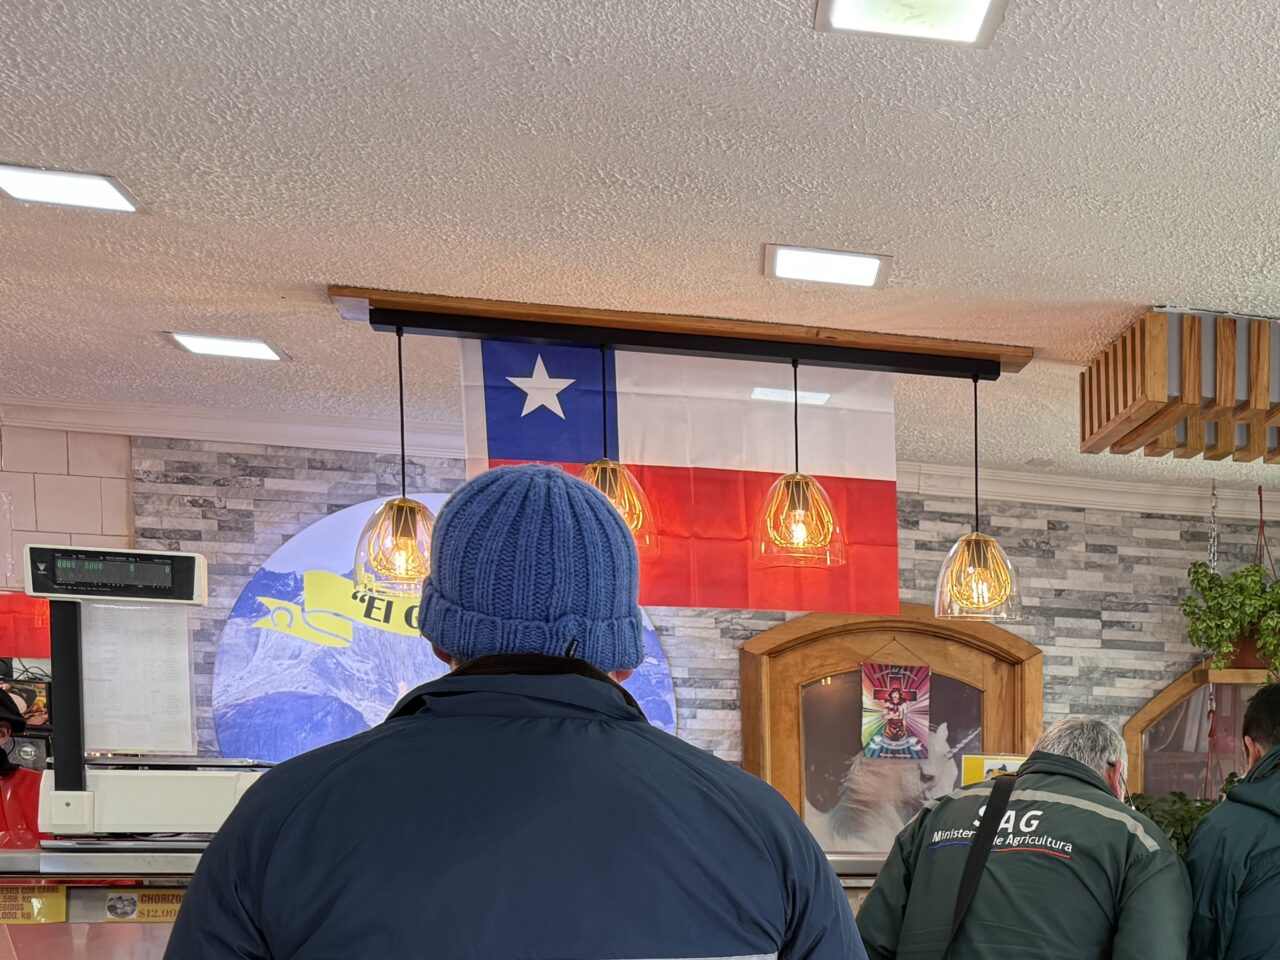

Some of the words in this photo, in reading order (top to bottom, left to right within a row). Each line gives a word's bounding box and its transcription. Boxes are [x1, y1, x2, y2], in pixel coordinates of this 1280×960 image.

[932, 828, 976, 843] Minister
[1006, 834, 1073, 853] Agricultura
[0, 904, 24, 912] EGIDOS
